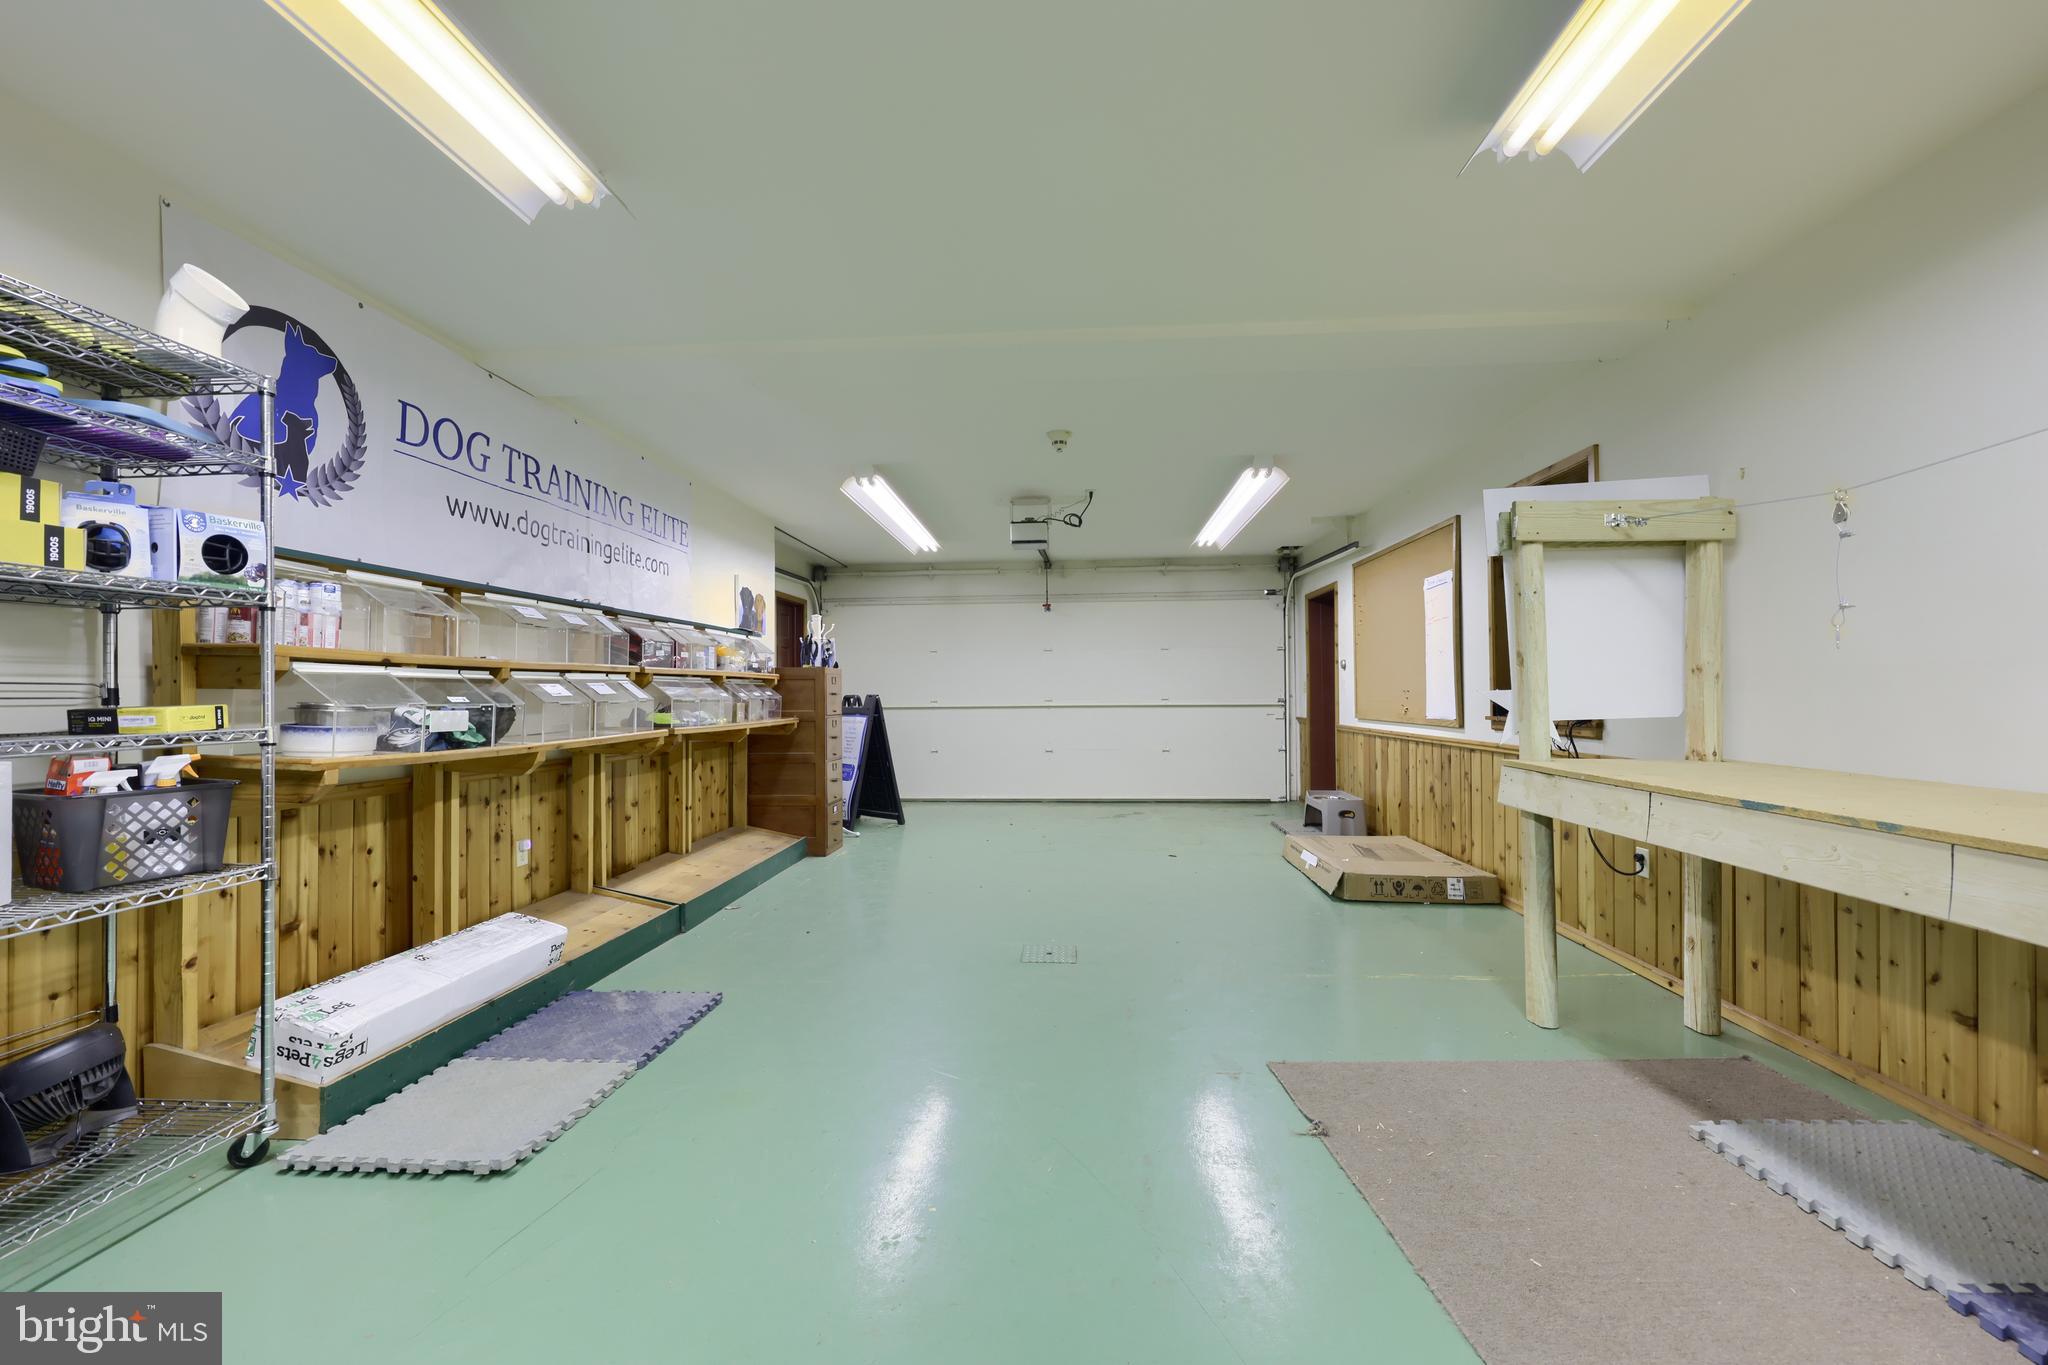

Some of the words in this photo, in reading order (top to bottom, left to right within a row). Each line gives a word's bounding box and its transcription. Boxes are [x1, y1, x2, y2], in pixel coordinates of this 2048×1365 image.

[396, 399, 491, 472] DOG
[502, 444, 635, 527] TRAINING
[640, 503, 689, 548] ELITE
[25, 488, 36, 514] 1900S
[75, 503, 127, 517] Baskerville
[208, 515, 262, 532] Baskerville
[446, 495, 669, 576] www.dogtrainingelite.com
[49, 536, 59, 562] 1900S
[48, 779, 66, 790] Hefty
